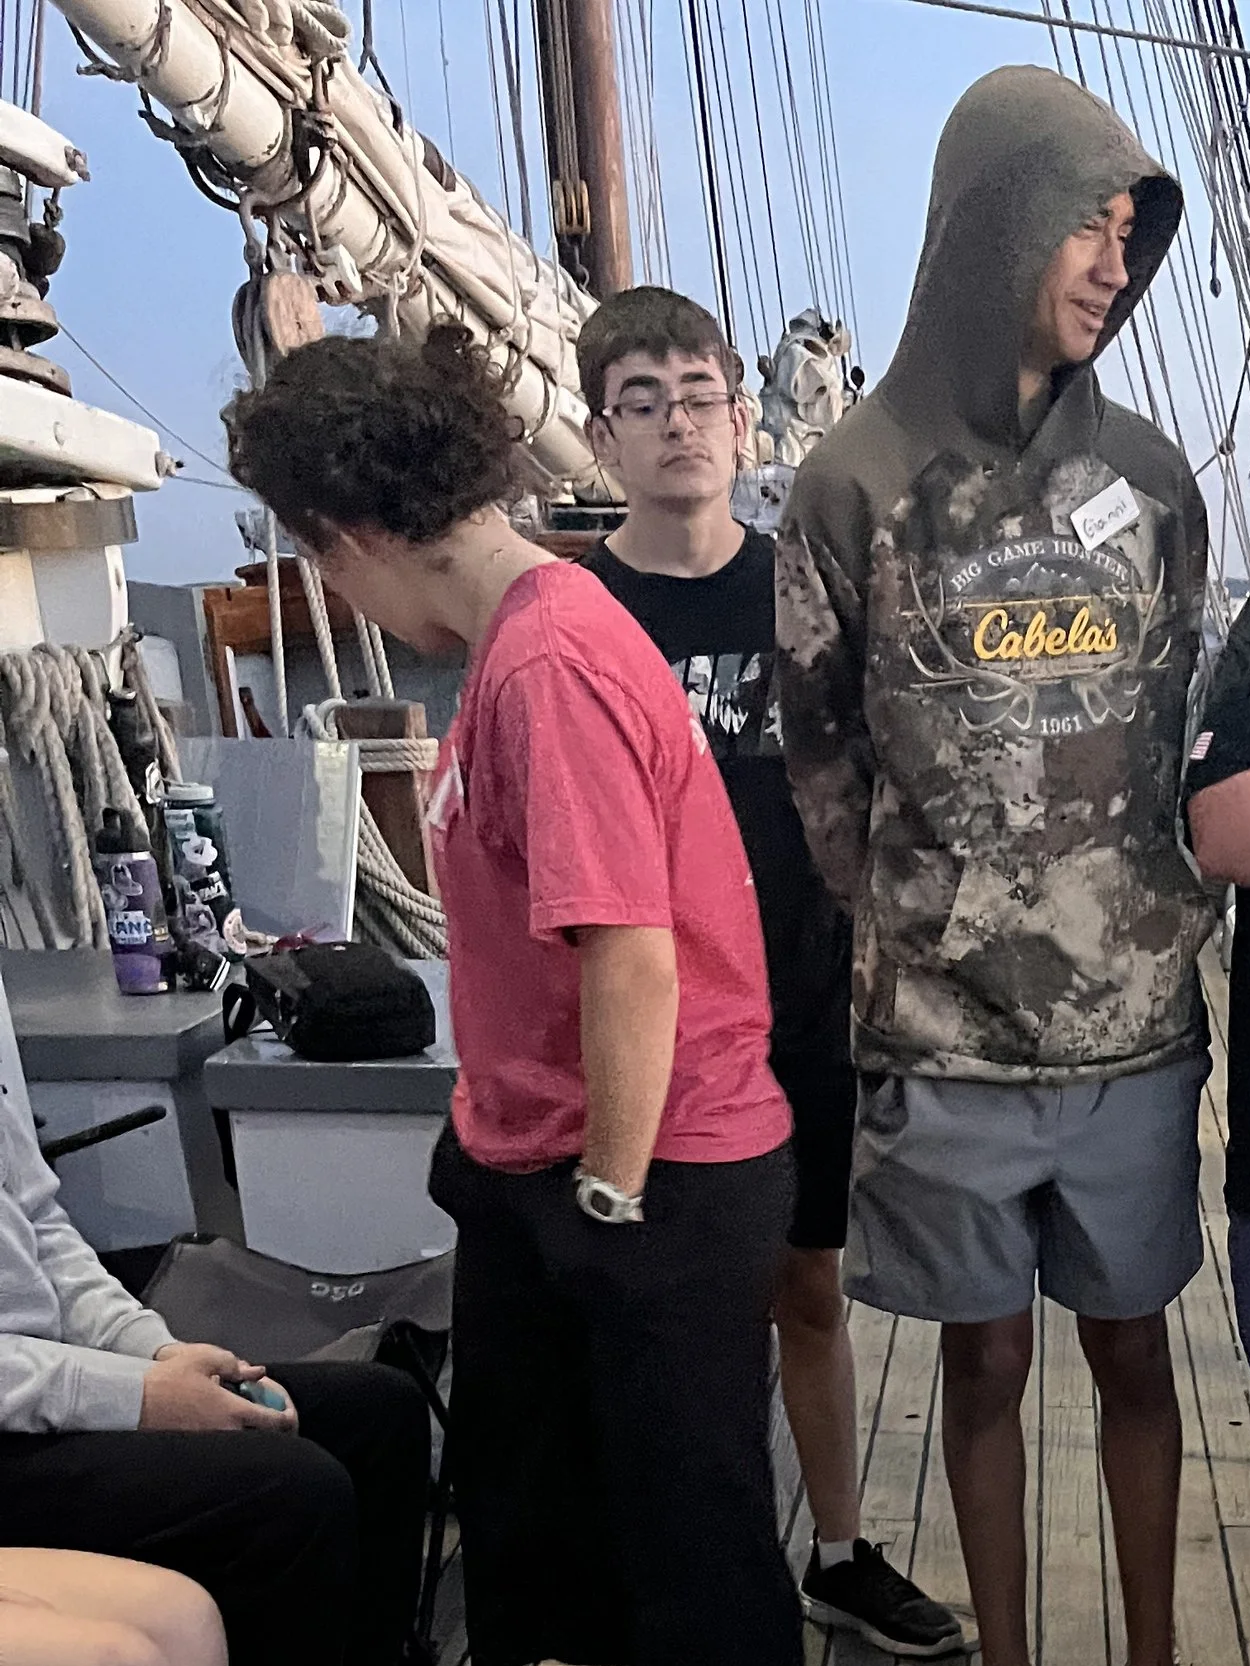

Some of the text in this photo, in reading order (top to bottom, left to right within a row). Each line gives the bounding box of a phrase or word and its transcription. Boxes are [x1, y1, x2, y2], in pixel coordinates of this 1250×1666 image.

[950, 562, 982, 592] BIG
[987, 540, 1045, 567] GAME
[973, 606, 1117, 661] Cabela's
[1040, 715, 1082, 736] 1961
